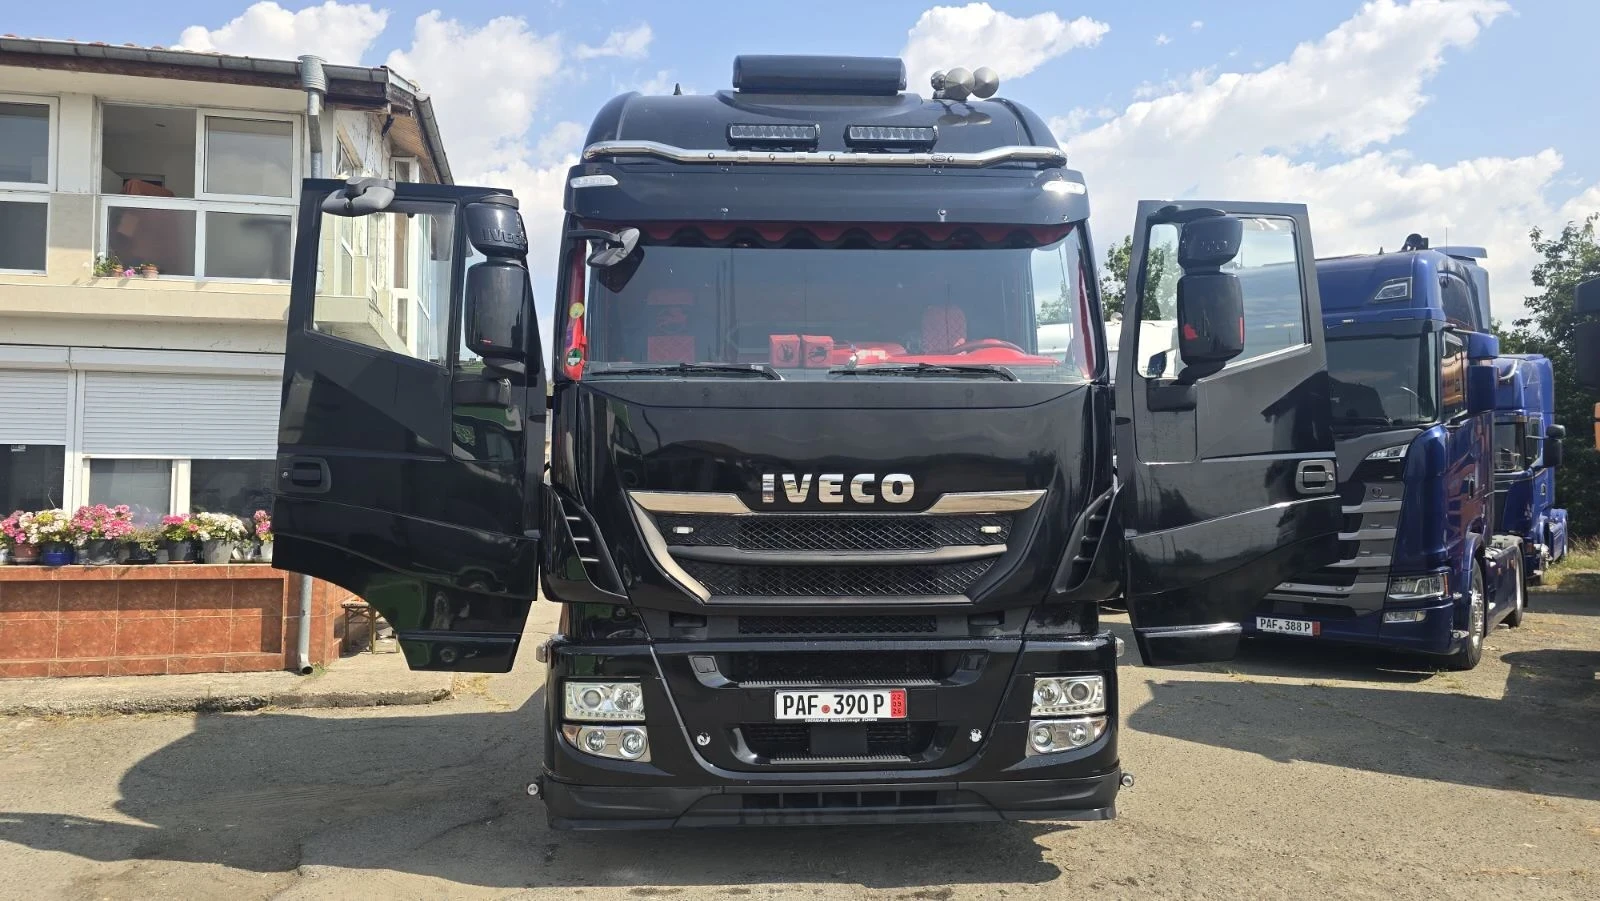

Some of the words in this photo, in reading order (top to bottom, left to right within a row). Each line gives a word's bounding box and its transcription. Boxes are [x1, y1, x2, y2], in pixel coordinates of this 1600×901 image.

[762, 473, 915, 503] IVECO
[1260, 619, 1278, 628] PAF
[1285, 621, 1302, 631] 388
[1304, 623, 1310, 632] P
[783, 695, 819, 715] PAF
[834, 694, 868, 715] 390
[873, 694, 884, 714] P
